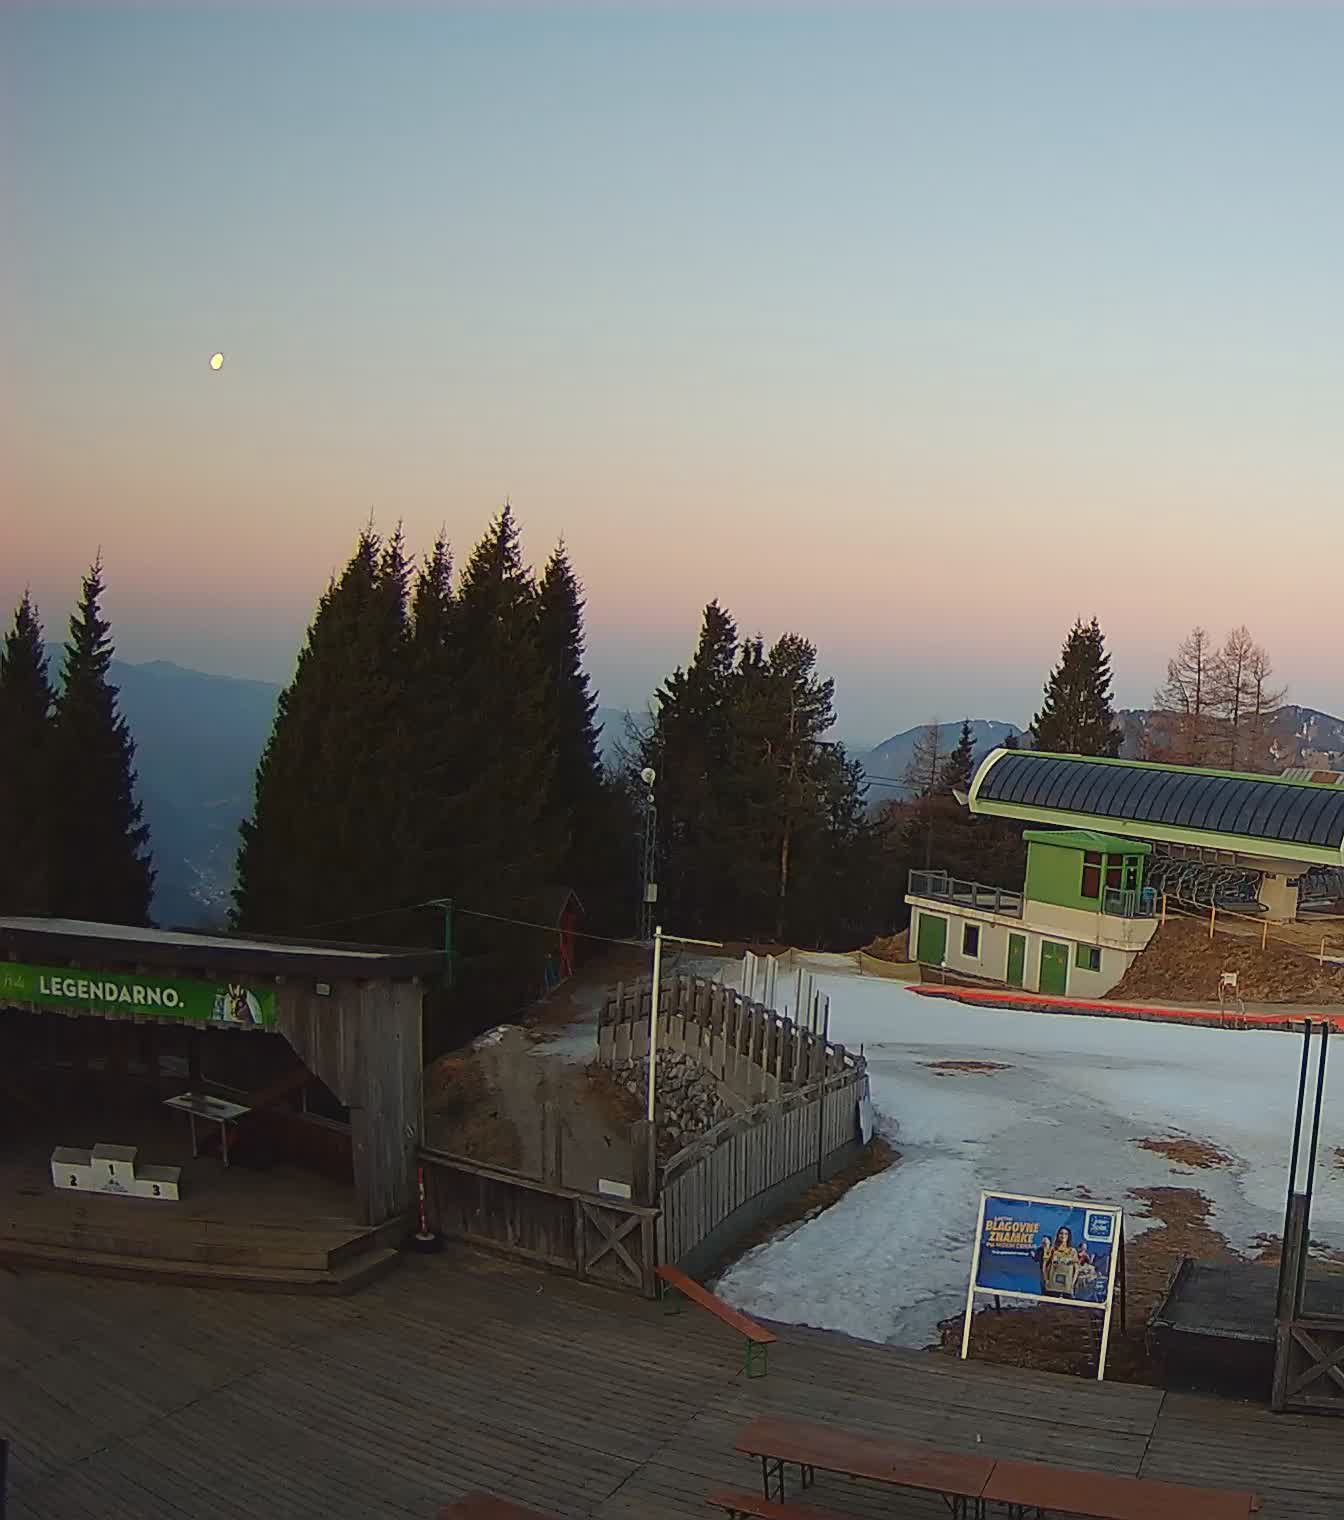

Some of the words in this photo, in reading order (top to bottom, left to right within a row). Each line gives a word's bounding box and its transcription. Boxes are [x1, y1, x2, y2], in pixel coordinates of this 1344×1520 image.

[39, 975, 185, 1008] LEGENDARNO.
[152, 1184, 161, 1196] 3
[986, 1220, 1040, 1232] BLAGOVNE
[990, 1232, 1034, 1243] ZNAMKE
